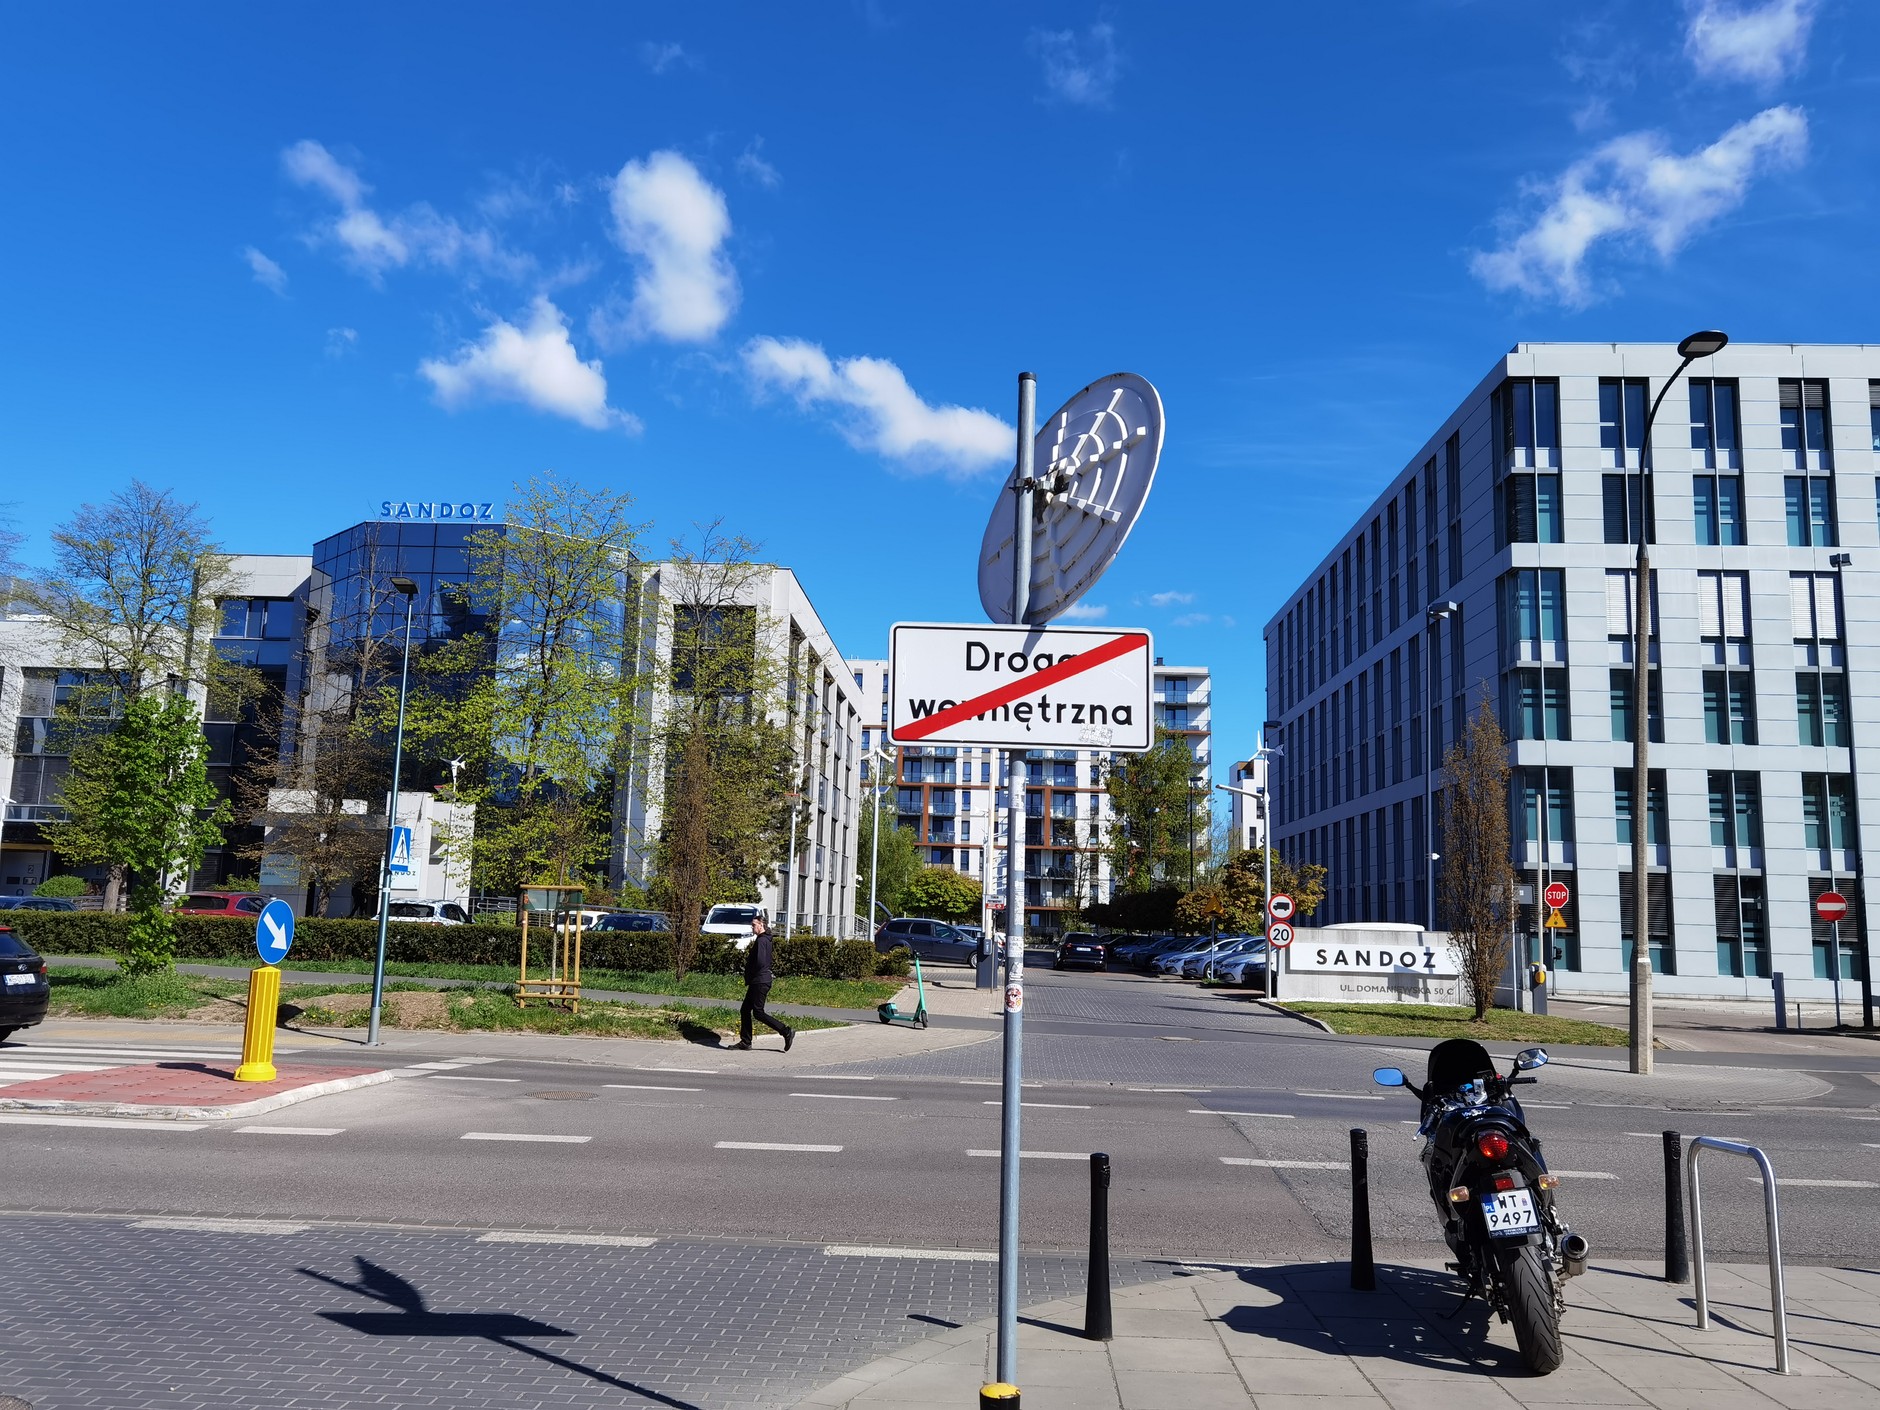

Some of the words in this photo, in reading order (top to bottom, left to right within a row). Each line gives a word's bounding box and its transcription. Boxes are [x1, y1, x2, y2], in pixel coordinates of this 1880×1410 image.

[381, 501, 495, 519] SANDOZ
[909, 694, 1133, 732] wenętrzna
[1547, 891, 1566, 900] STOP
[1272, 928, 1290, 941] 20
[1316, 949, 1436, 968] SANDOZ
[1340, 984, 1354, 992] UL.
[1356, 985, 1431, 995] DOMANIEWSKA
[1497, 1195, 1517, 1209] WT
[1490, 1210, 1531, 1227] 9497
